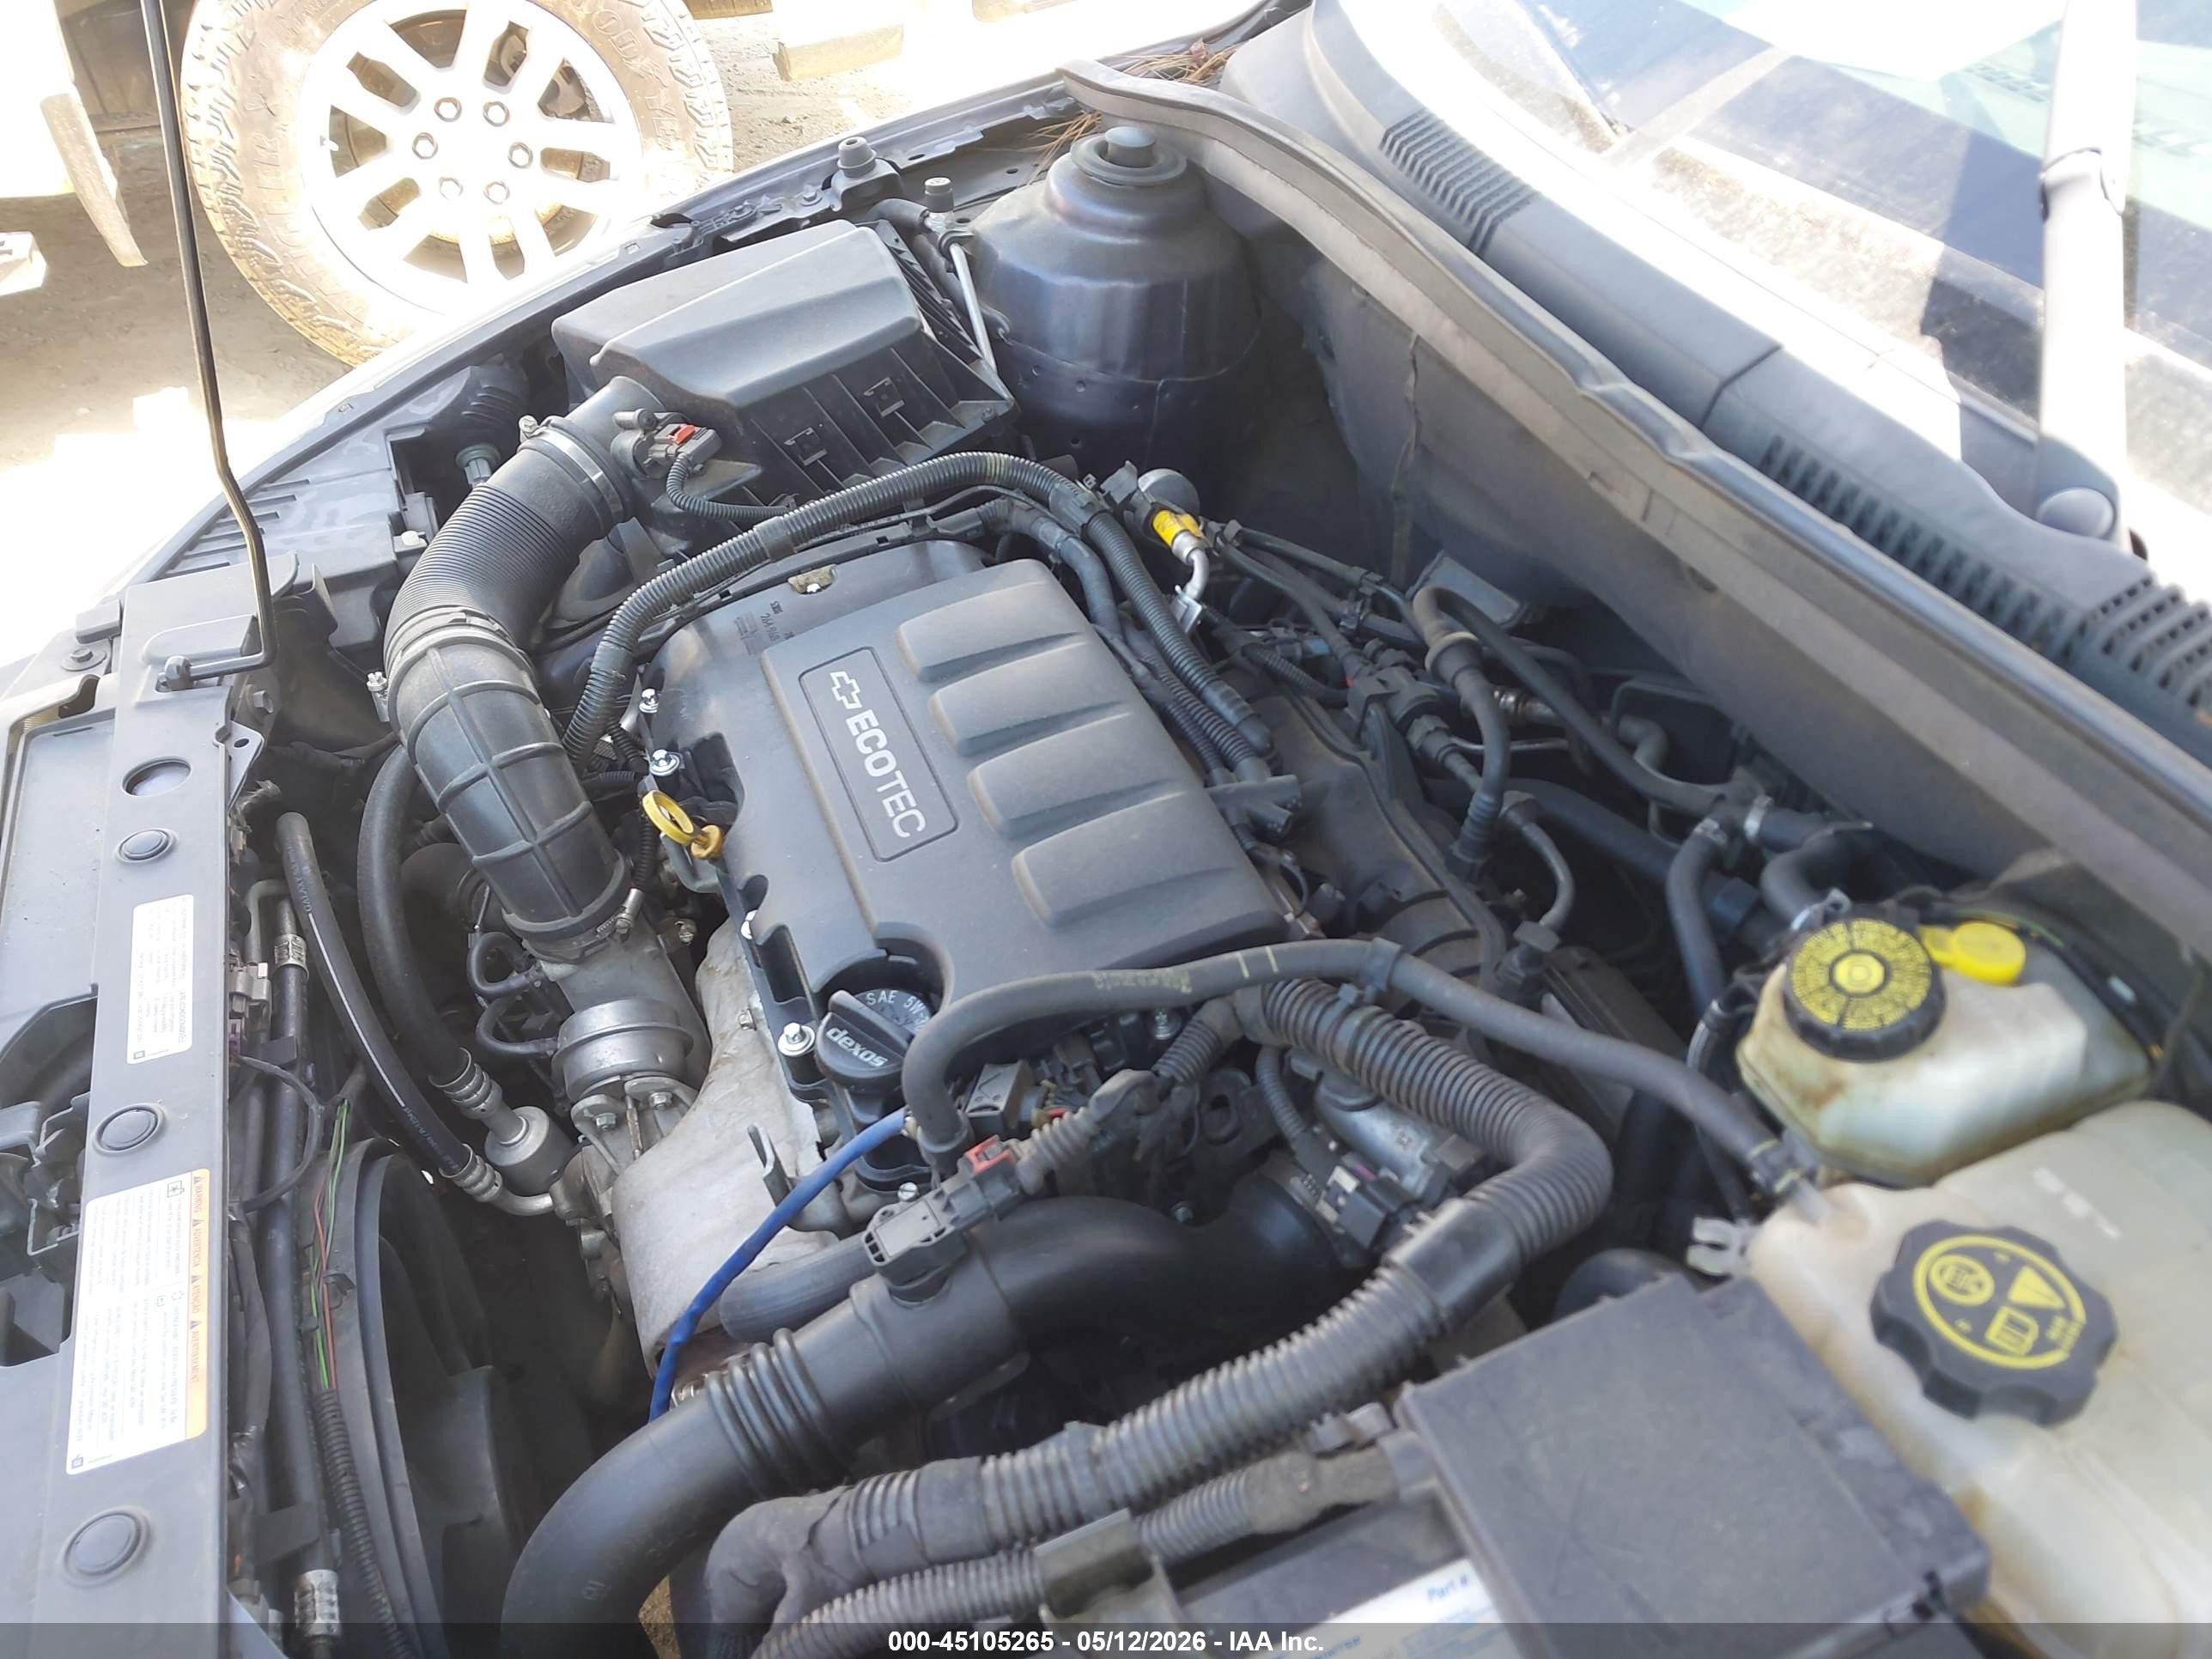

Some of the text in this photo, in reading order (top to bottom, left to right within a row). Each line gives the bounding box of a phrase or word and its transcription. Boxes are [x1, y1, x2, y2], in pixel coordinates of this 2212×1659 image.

[846, 709, 926, 838] ECOTEC
[866, 990, 896, 1005] SAE
[825, 1027, 889, 1066] dexos
[192, 1185, 204, 1213] WARNING
